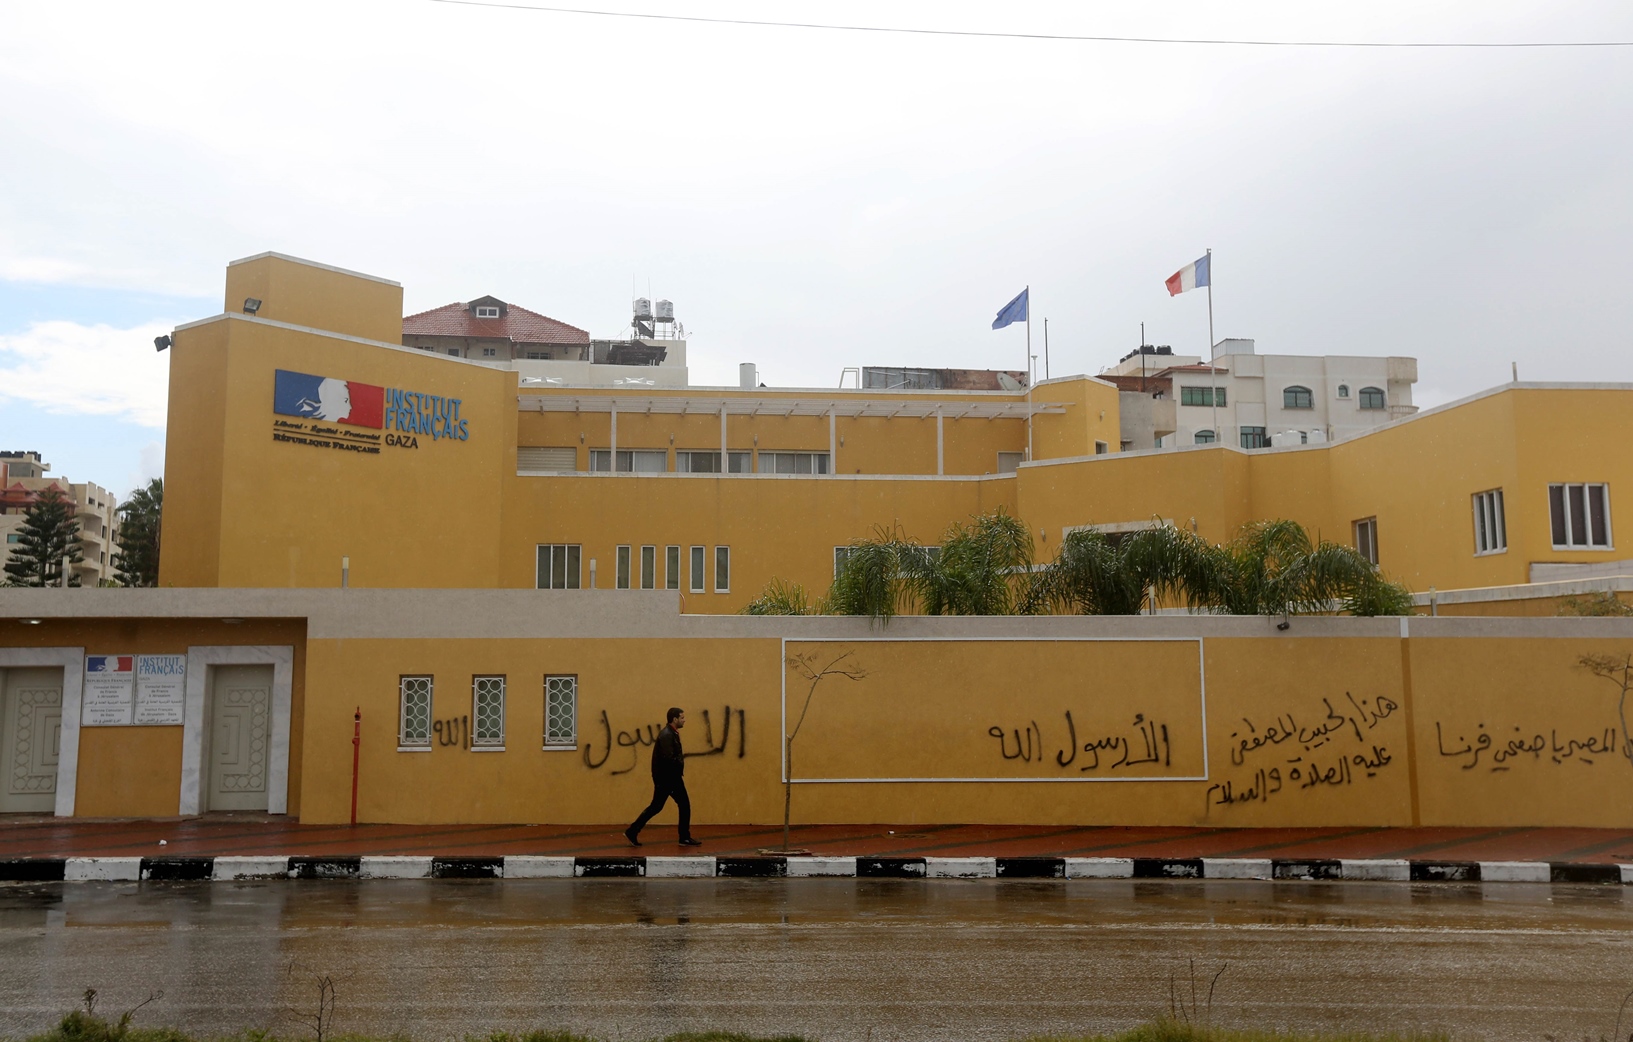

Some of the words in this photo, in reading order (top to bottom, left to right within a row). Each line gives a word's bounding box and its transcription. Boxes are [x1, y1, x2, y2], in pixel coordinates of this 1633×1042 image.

[386, 388, 462, 421] INSTITUT
[385, 434, 418, 449] GAZA
[139, 656, 180, 667] INSTITUT
[1346, 691, 1399, 729] هذا
[432, 715, 468, 750] الله
[582, 709, 663, 776] سول
[988, 719, 1042, 763] الله
[1056, 709, 1129, 772] رسول
[1435, 721, 1493, 770] فرنسا
[1353, 744, 1392, 778] عليه
